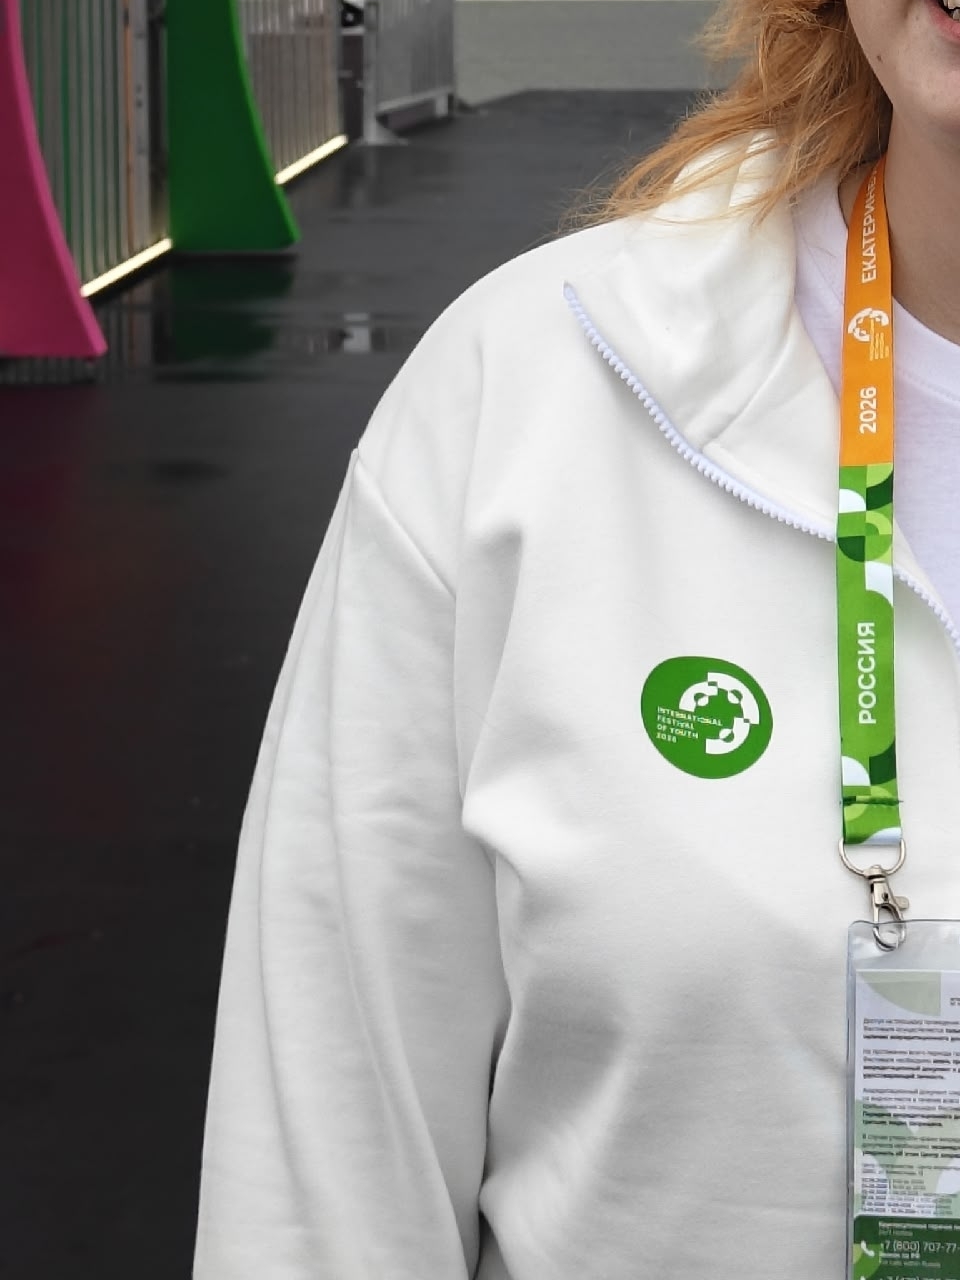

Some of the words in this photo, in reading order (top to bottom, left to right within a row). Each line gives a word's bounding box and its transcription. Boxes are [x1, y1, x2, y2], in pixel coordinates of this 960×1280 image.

[860, 386, 877, 434] 2026
[857, 622, 876, 724] РОССИЯ
[670, 727, 699, 739] YOUTH
[893, 1240, 920, 1253] (800)
